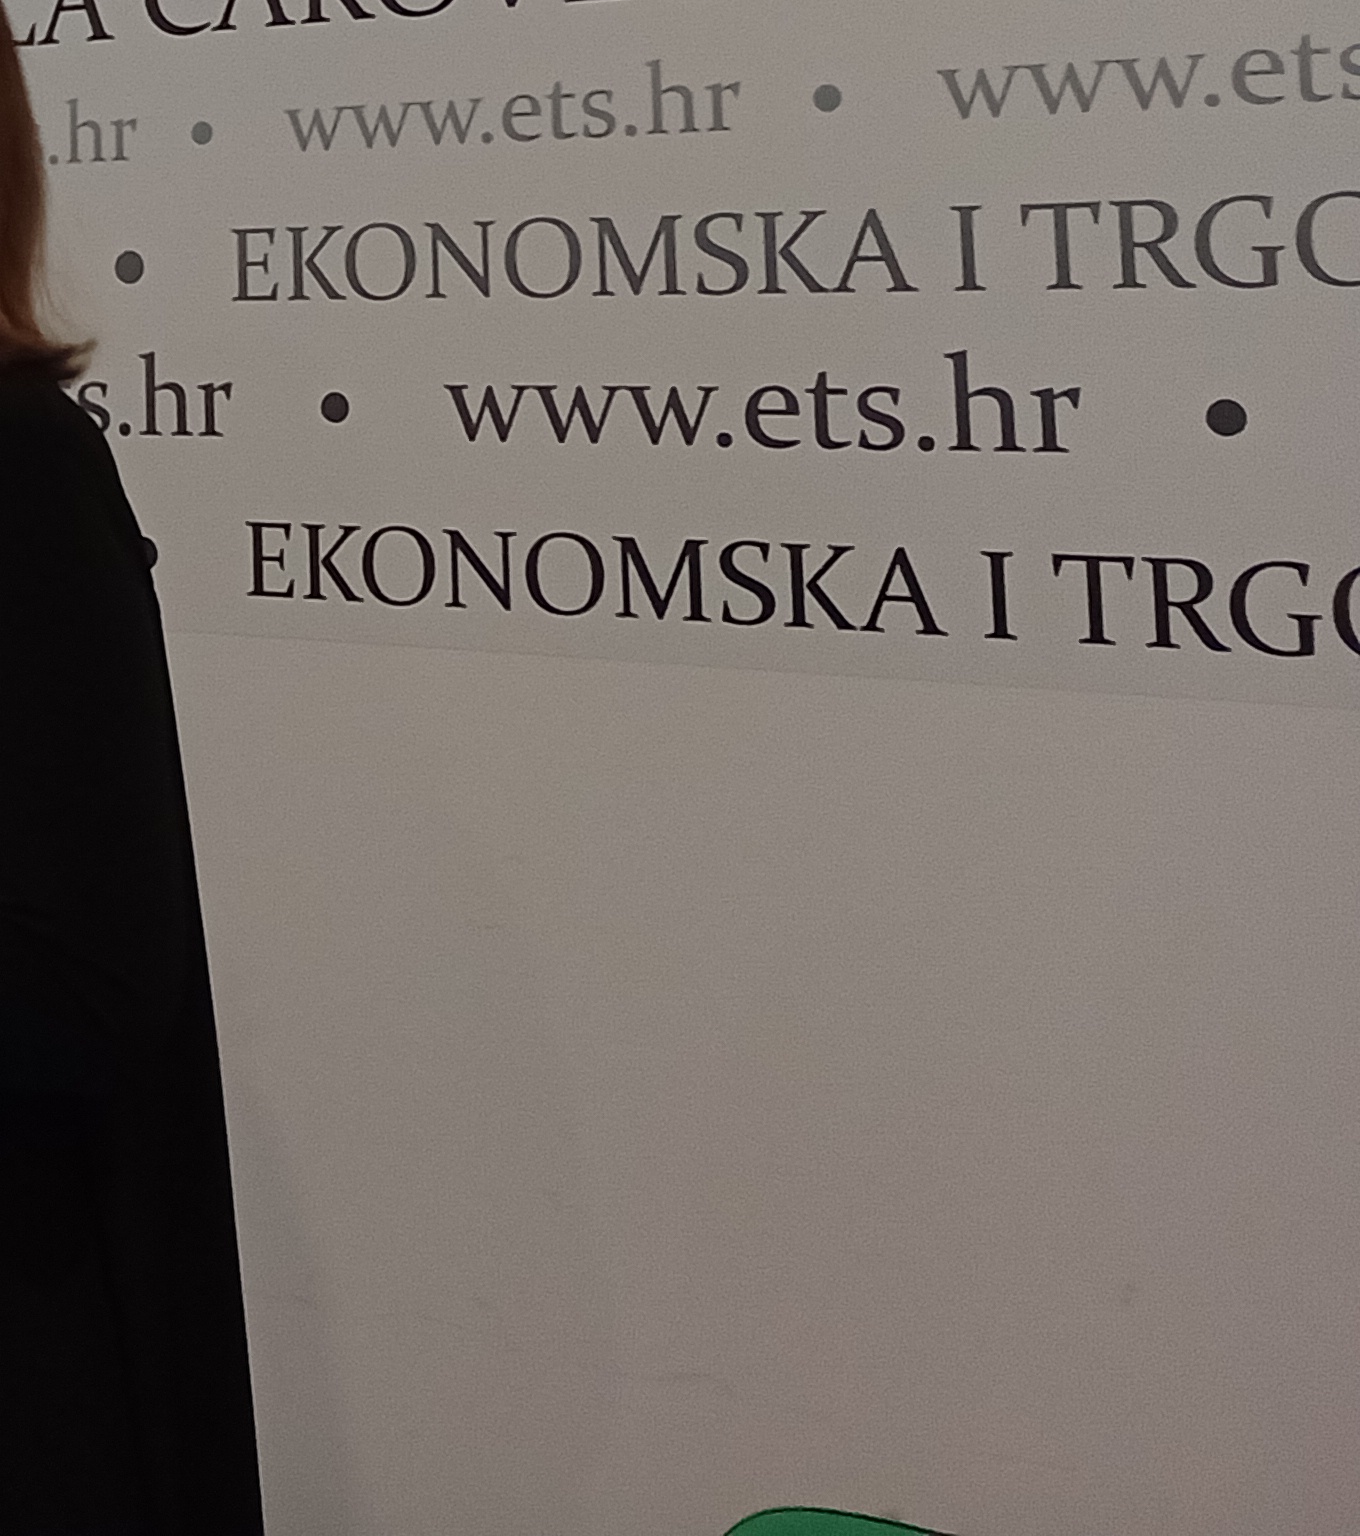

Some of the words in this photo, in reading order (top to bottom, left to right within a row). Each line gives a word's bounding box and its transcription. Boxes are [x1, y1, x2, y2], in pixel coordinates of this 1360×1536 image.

[284, 60, 741, 152] www.ets.hr
[231, 207, 919, 302] EKONOMSKA
[950, 205, 987, 292] I
[444, 350, 1081, 454] www.ets.hr
[245, 520, 949, 638] EKONOMSKA
[980, 549, 1018, 641] I
[1051, 552, 1360, 658] TRG
